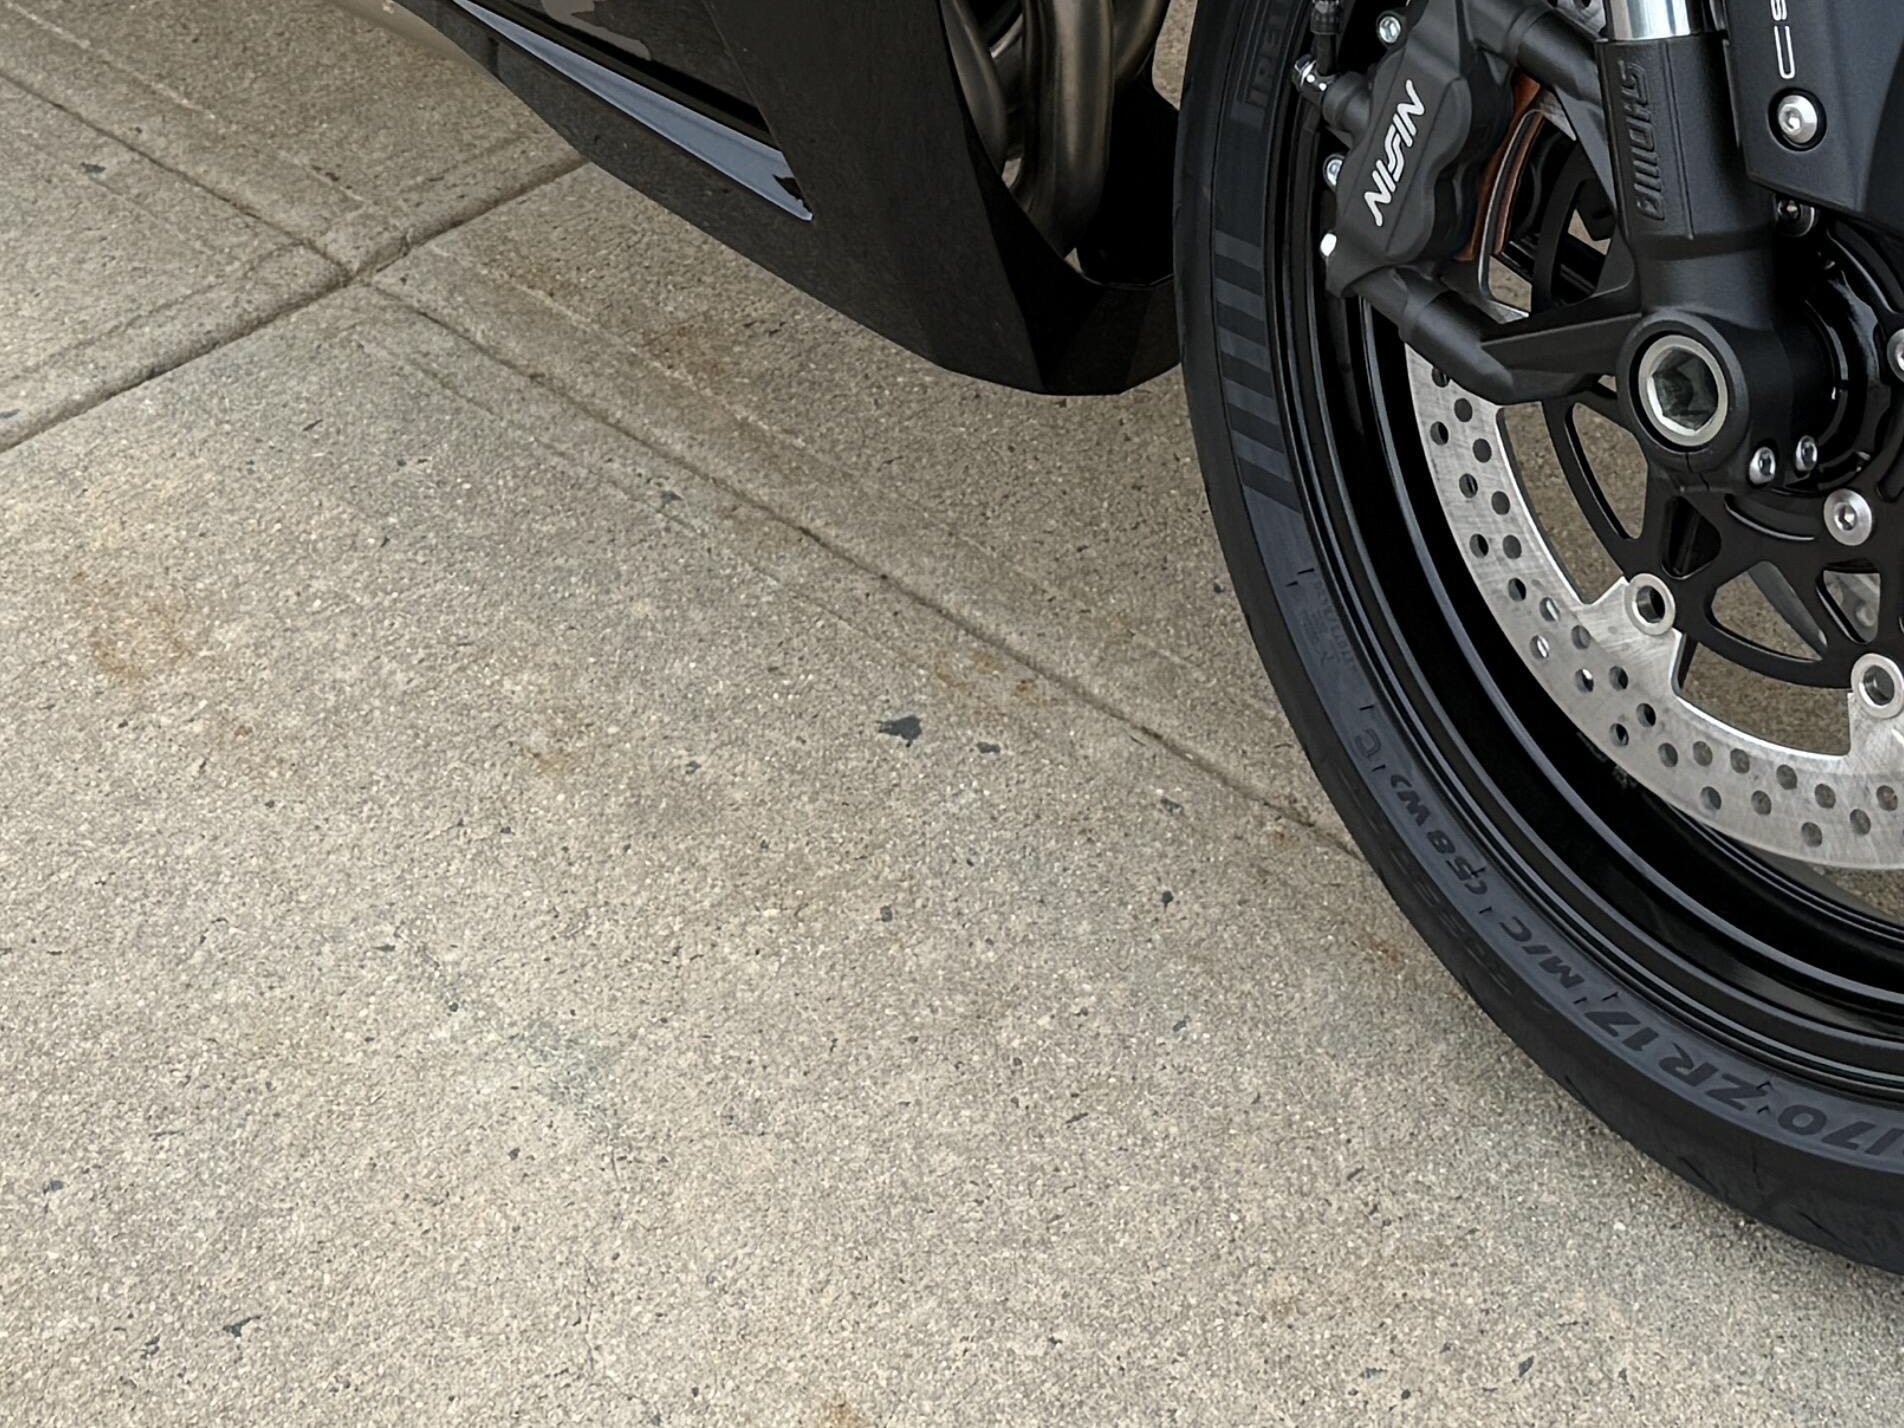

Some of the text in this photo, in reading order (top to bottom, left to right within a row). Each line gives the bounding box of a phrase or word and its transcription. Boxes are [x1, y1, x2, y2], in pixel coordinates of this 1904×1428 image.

[1364, 79, 1426, 227] NISSIN
[1619, 58, 1666, 221] SHOWA
[1389, 773, 1488, 896] (58W)
[1499, 916, 1586, 992] M/C
